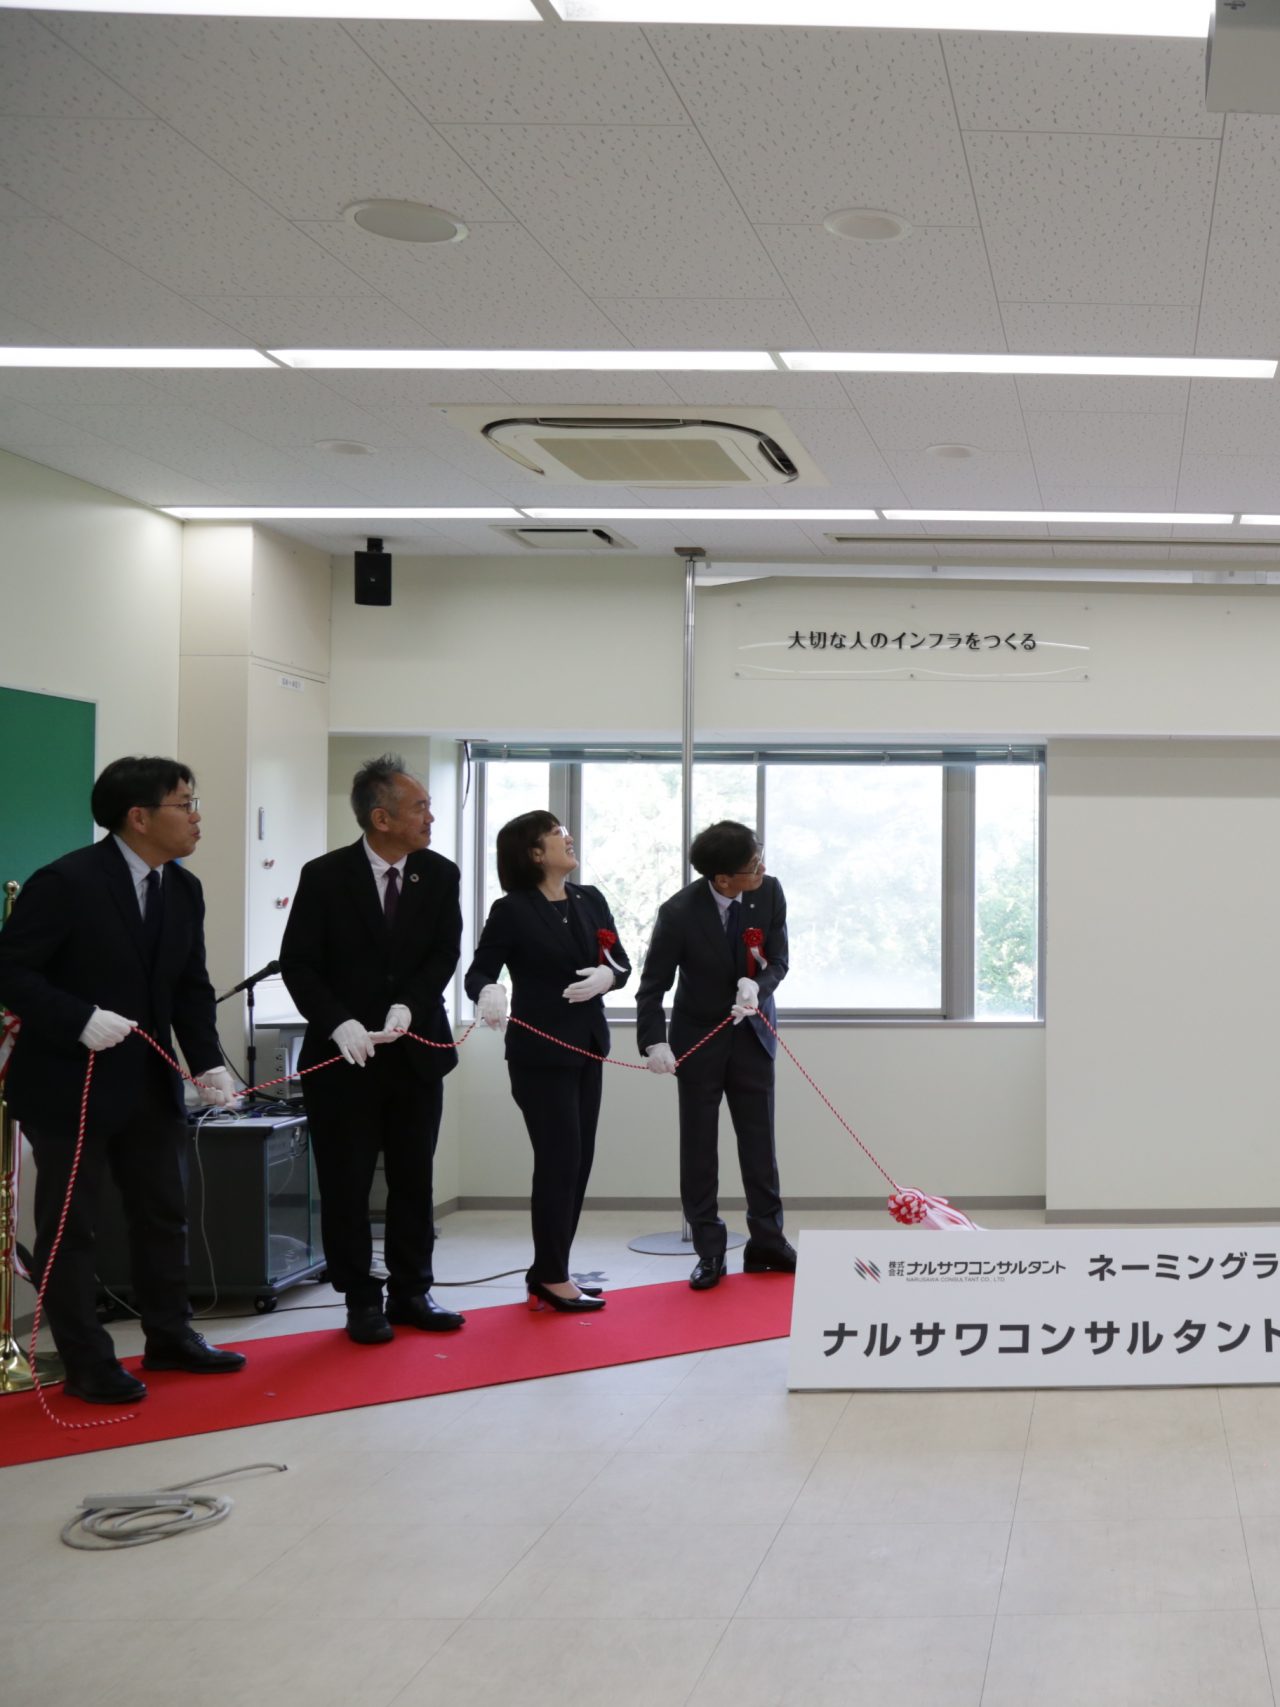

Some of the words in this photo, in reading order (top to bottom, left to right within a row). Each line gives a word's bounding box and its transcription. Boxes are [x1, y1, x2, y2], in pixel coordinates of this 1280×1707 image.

[788, 631, 1037, 651] 大切な人のインフラをつくる
[907, 1260, 1067, 1276] ナルサワコンサルタント
